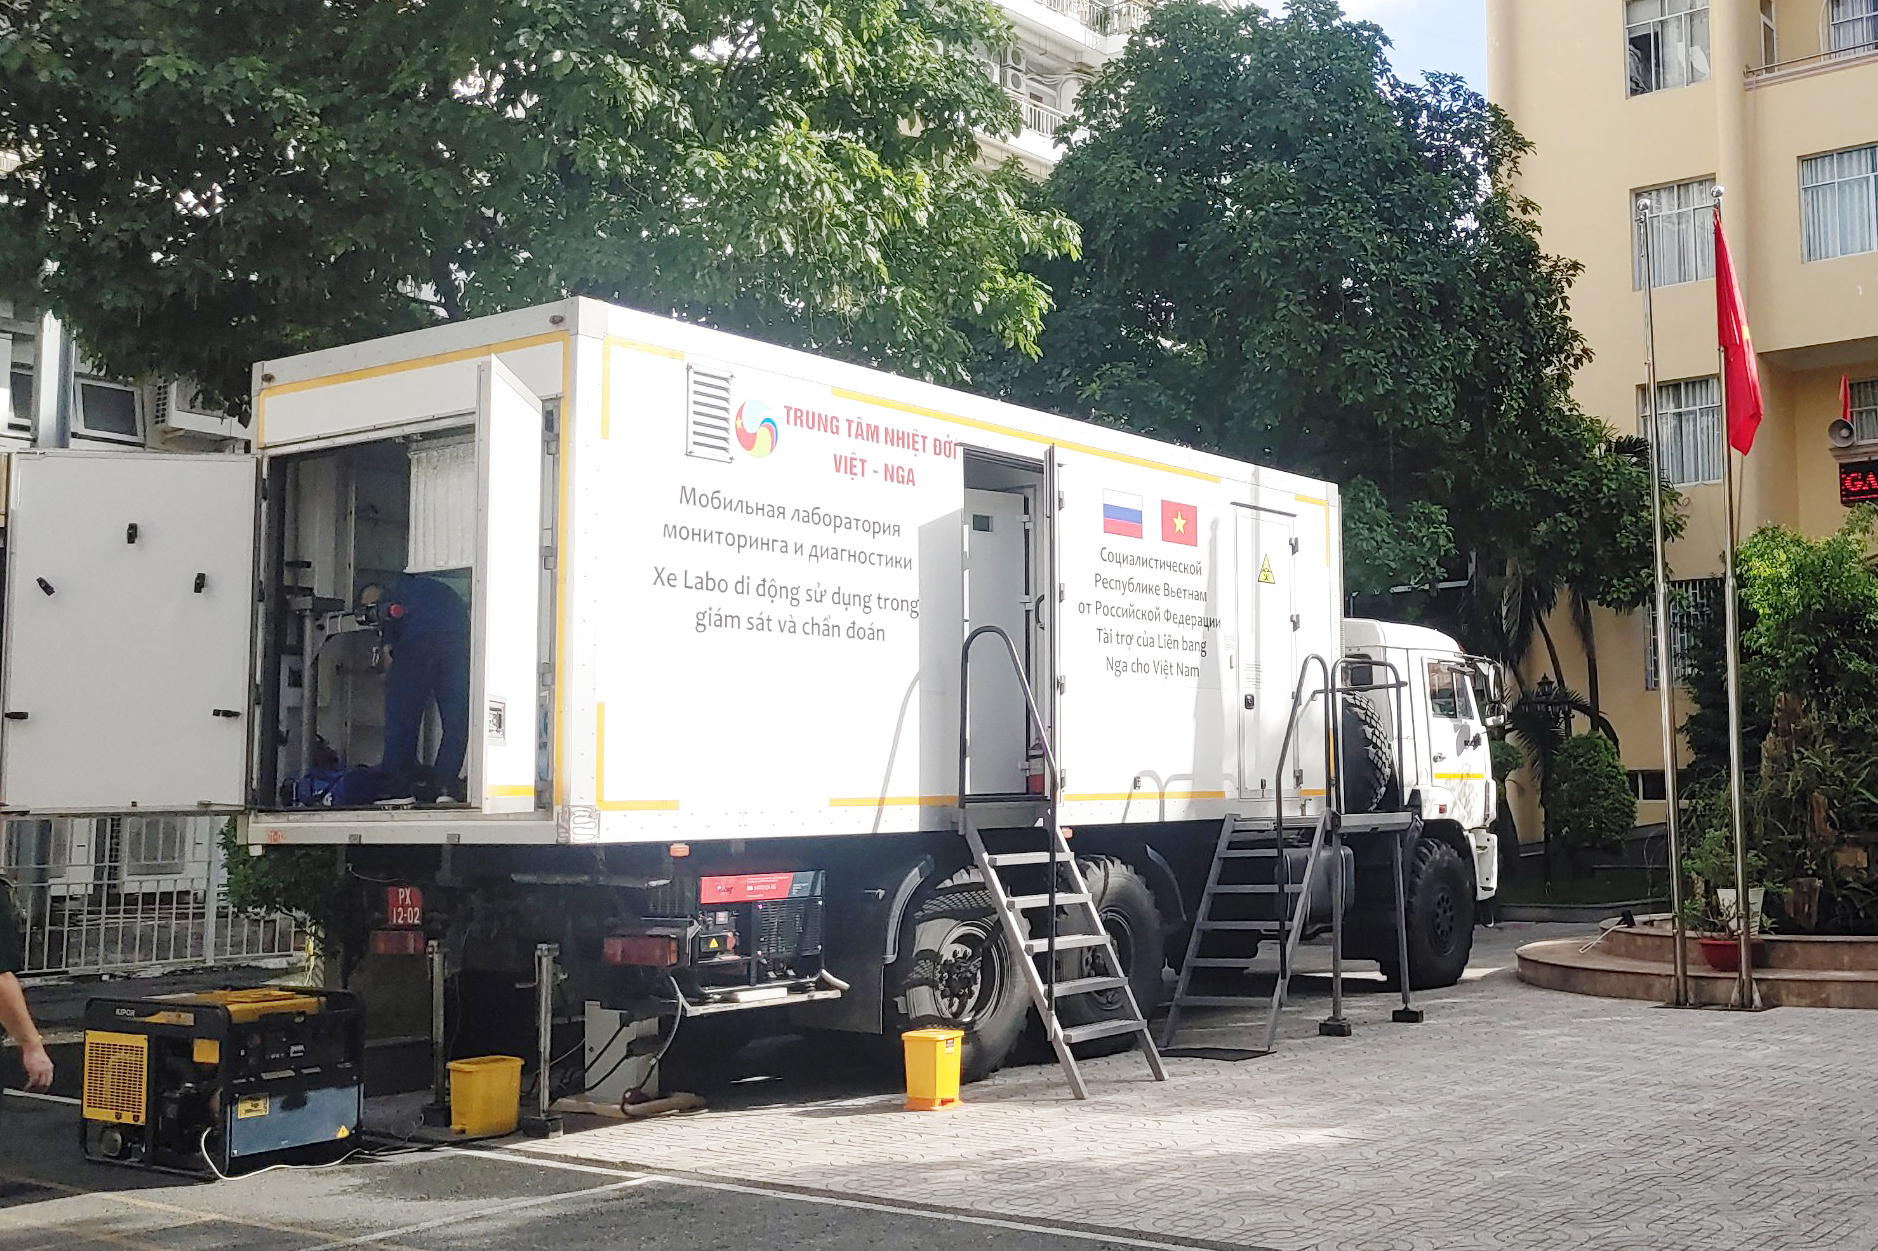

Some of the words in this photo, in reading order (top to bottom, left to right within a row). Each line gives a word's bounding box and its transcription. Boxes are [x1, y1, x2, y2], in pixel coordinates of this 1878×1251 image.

[783, 405, 840, 436] TRUNG
[846, 416, 880, 444] TÂM
[884, 428, 929, 457] NHIỆT
[933, 434, 957, 460] ĐỚI
[833, 451, 867, 481] VIỆT
[884, 463, 916, 487] NGA
[679, 485, 786, 520] Мобильная
[790, 506, 901, 540] лаборатория
[663, 523, 789, 554] мониторинга
[794, 541, 804, 556] и
[808, 544, 912, 570] диагностики
[1099, 546, 1202, 576] Социалистической
[652, 565, 678, 588] Xe
[684, 569, 729, 593] Labo
[734, 574, 751, 596] di
[755, 577, 801, 607] động
[805, 581, 827, 603] sử
[831, 585, 873, 614] dụng
[876, 592, 920, 620] trong
[1094, 572, 1161, 596] Республике
[1163, 582, 1208, 603] Вьетнам
[695, 606, 741, 633] giám
[746, 611, 773, 632] sát
[777, 613, 797, 634] và
[802, 614, 841, 638] chẩn
[846, 620, 885, 642] đoán
[1078, 601, 1092, 615] от
[1095, 600, 1161, 623] Российской
[1163, 608, 1221, 632] Федерации
[1096, 627, 1113, 644] Tài
[1115, 630, 1134, 651] trợ
[1136, 629, 1155, 648] của
[1157, 633, 1179, 650] Liên
[1181, 635, 1207, 658] bang
[1106, 656, 1128, 677] Nga
[1130, 657, 1150, 674] cho
[1152, 659, 1174, 680] Việt
[1176, 661, 1200, 678] Nam
[398, 887, 412, 906] PX
[392, 906, 421, 925] 12-02
